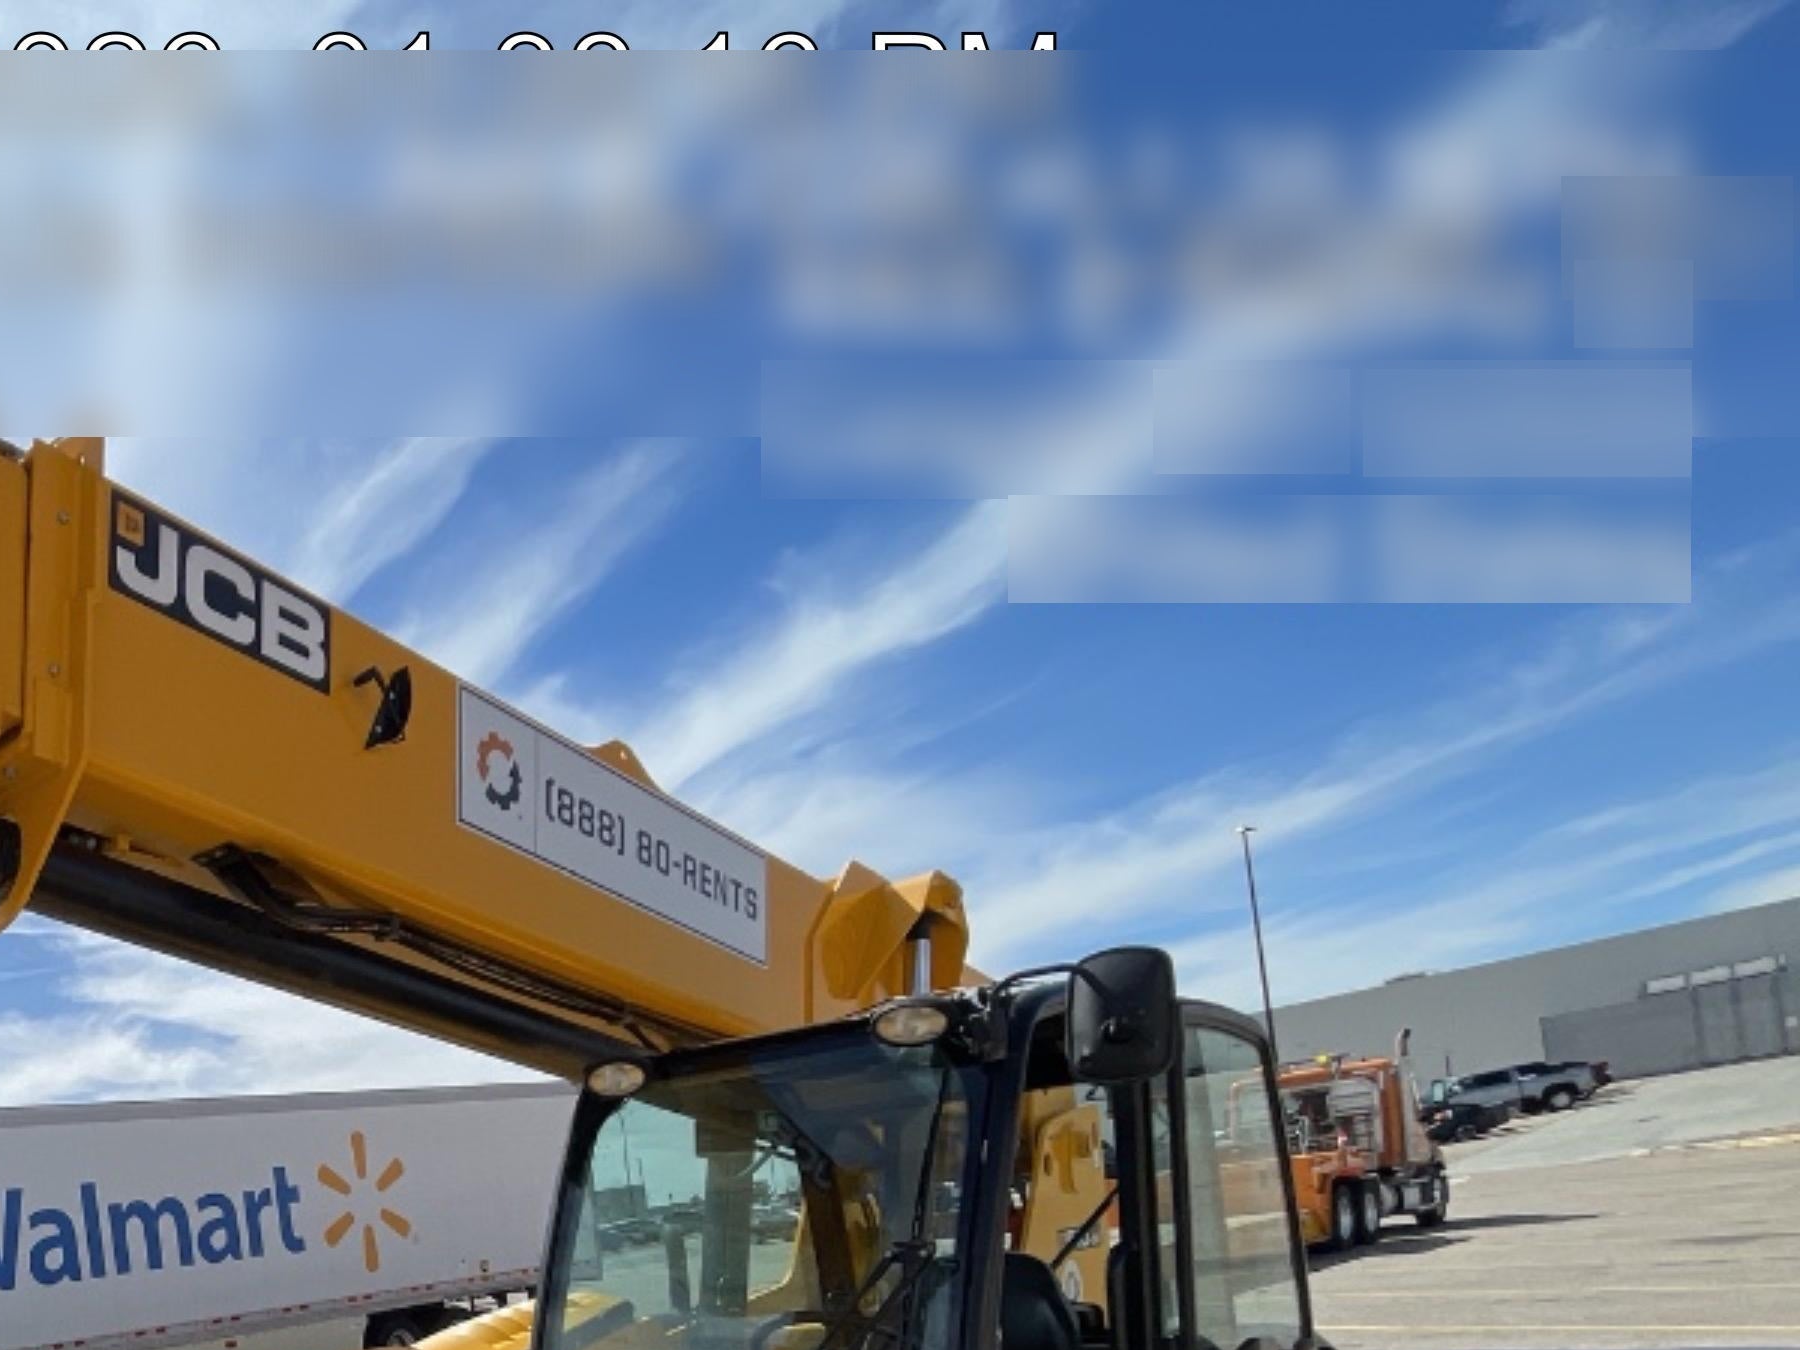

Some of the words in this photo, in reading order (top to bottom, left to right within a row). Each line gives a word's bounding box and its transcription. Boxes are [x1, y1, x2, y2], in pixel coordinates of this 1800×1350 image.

[116, 523, 327, 681] JCB
[545, 777, 625, 856] (888)
[637, 829, 758, 922] 80-RENTS
